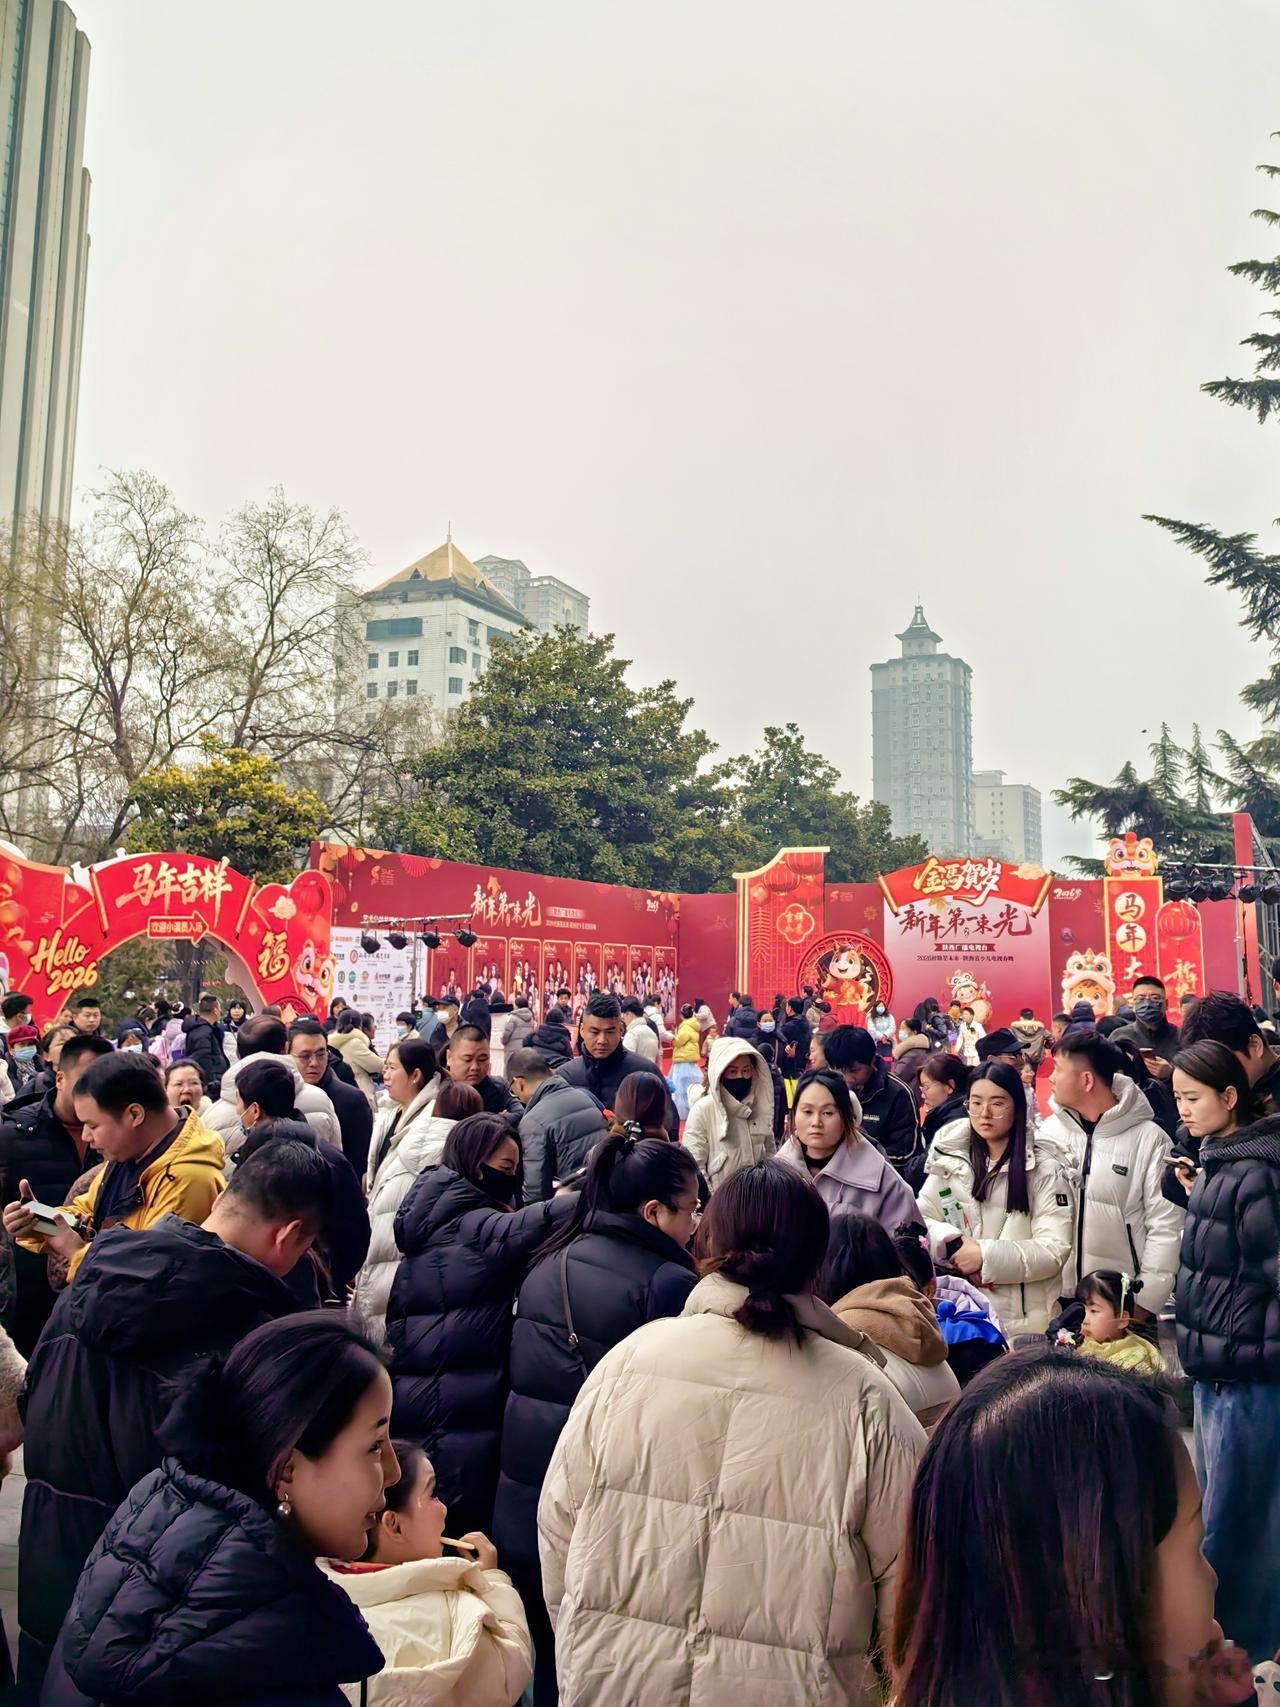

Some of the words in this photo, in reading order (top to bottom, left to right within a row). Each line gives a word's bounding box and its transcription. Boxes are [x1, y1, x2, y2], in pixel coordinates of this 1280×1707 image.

[115, 856, 232, 928] 马年吉祥
[470, 884, 541, 928] 新年第一束光
[899, 904, 1032, 940] 新年第一束光
[29, 928, 92, 973] Hello
[256, 929, 291, 985] 福
[46, 961, 98, 996] 2026
